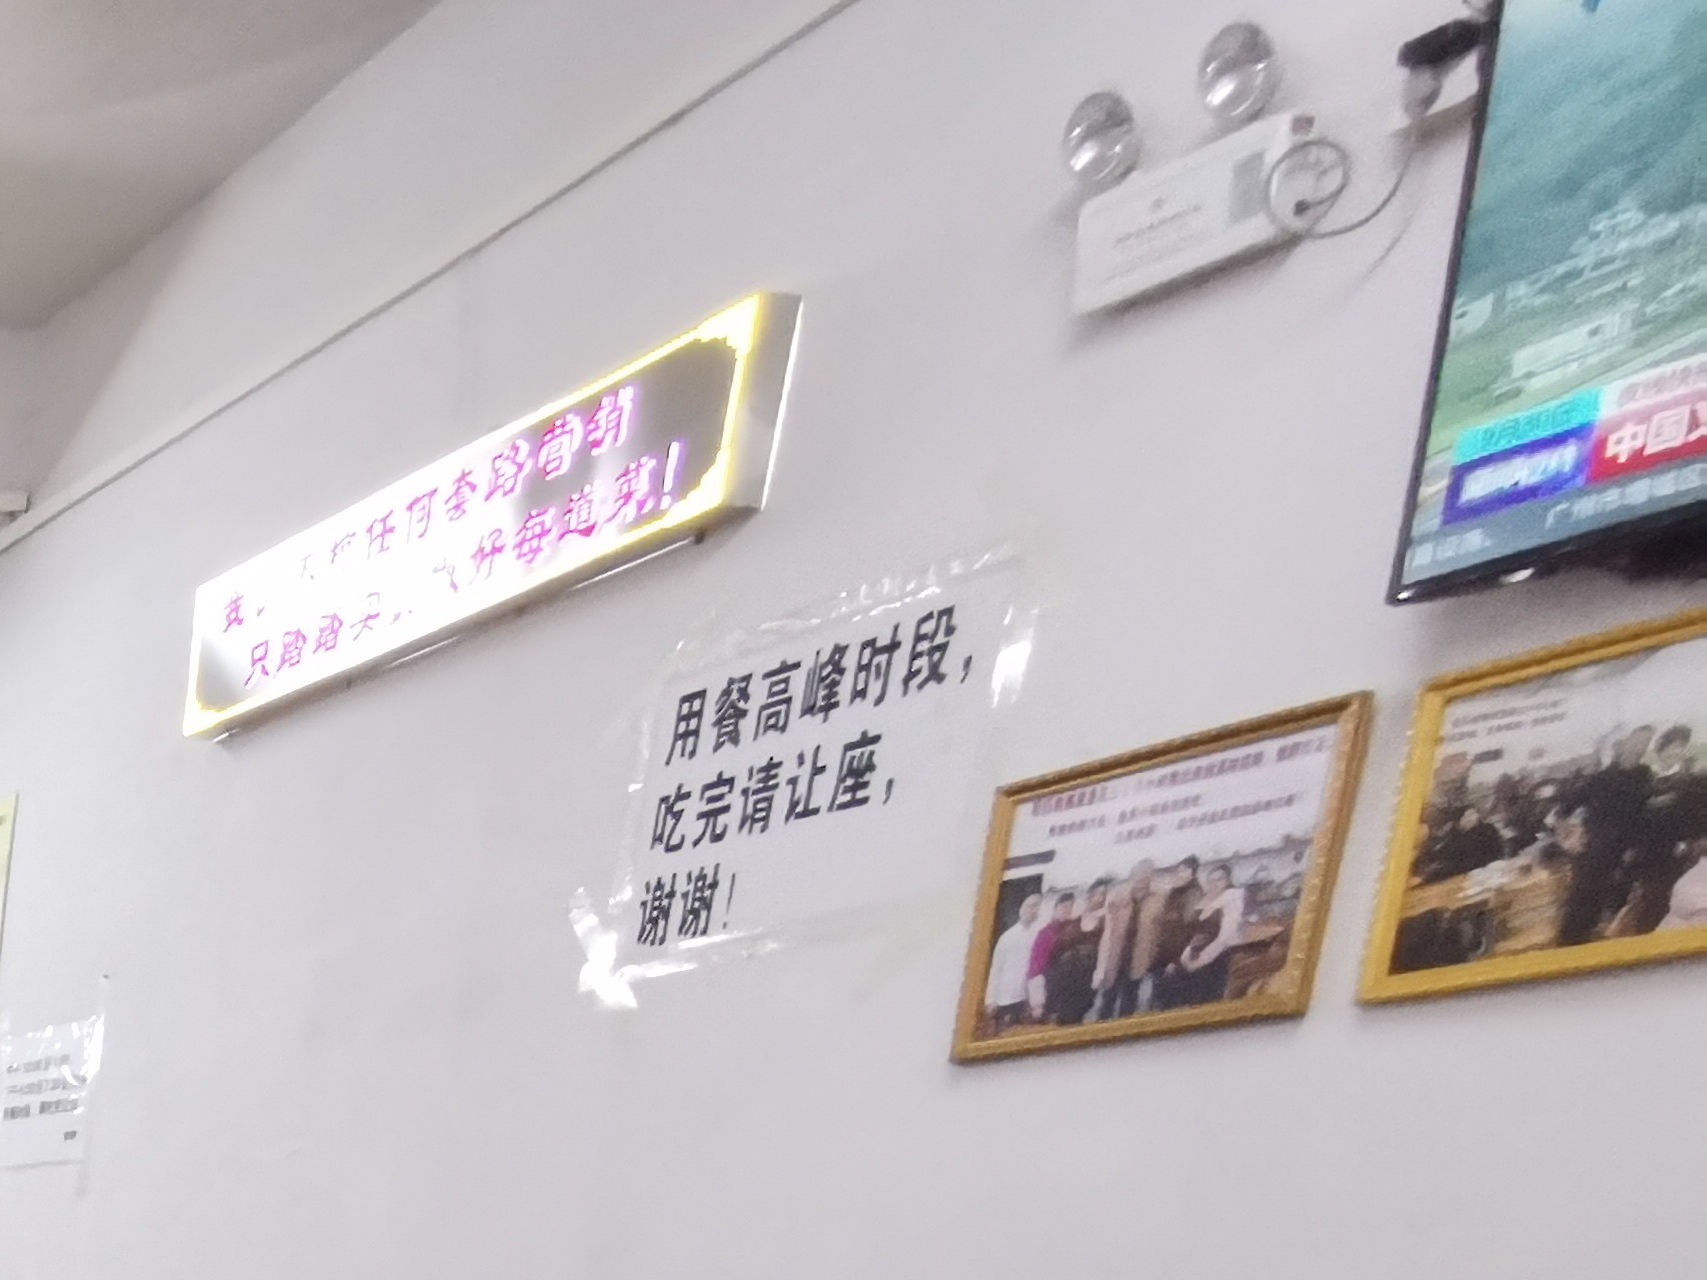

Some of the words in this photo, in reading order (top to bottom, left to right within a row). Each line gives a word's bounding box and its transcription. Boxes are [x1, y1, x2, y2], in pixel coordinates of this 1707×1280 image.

[665, 604, 974, 767] 用餐高峰时段，
[649, 729, 894, 854] 吃完请让座，
[636, 862, 737, 947] 谢谢！
